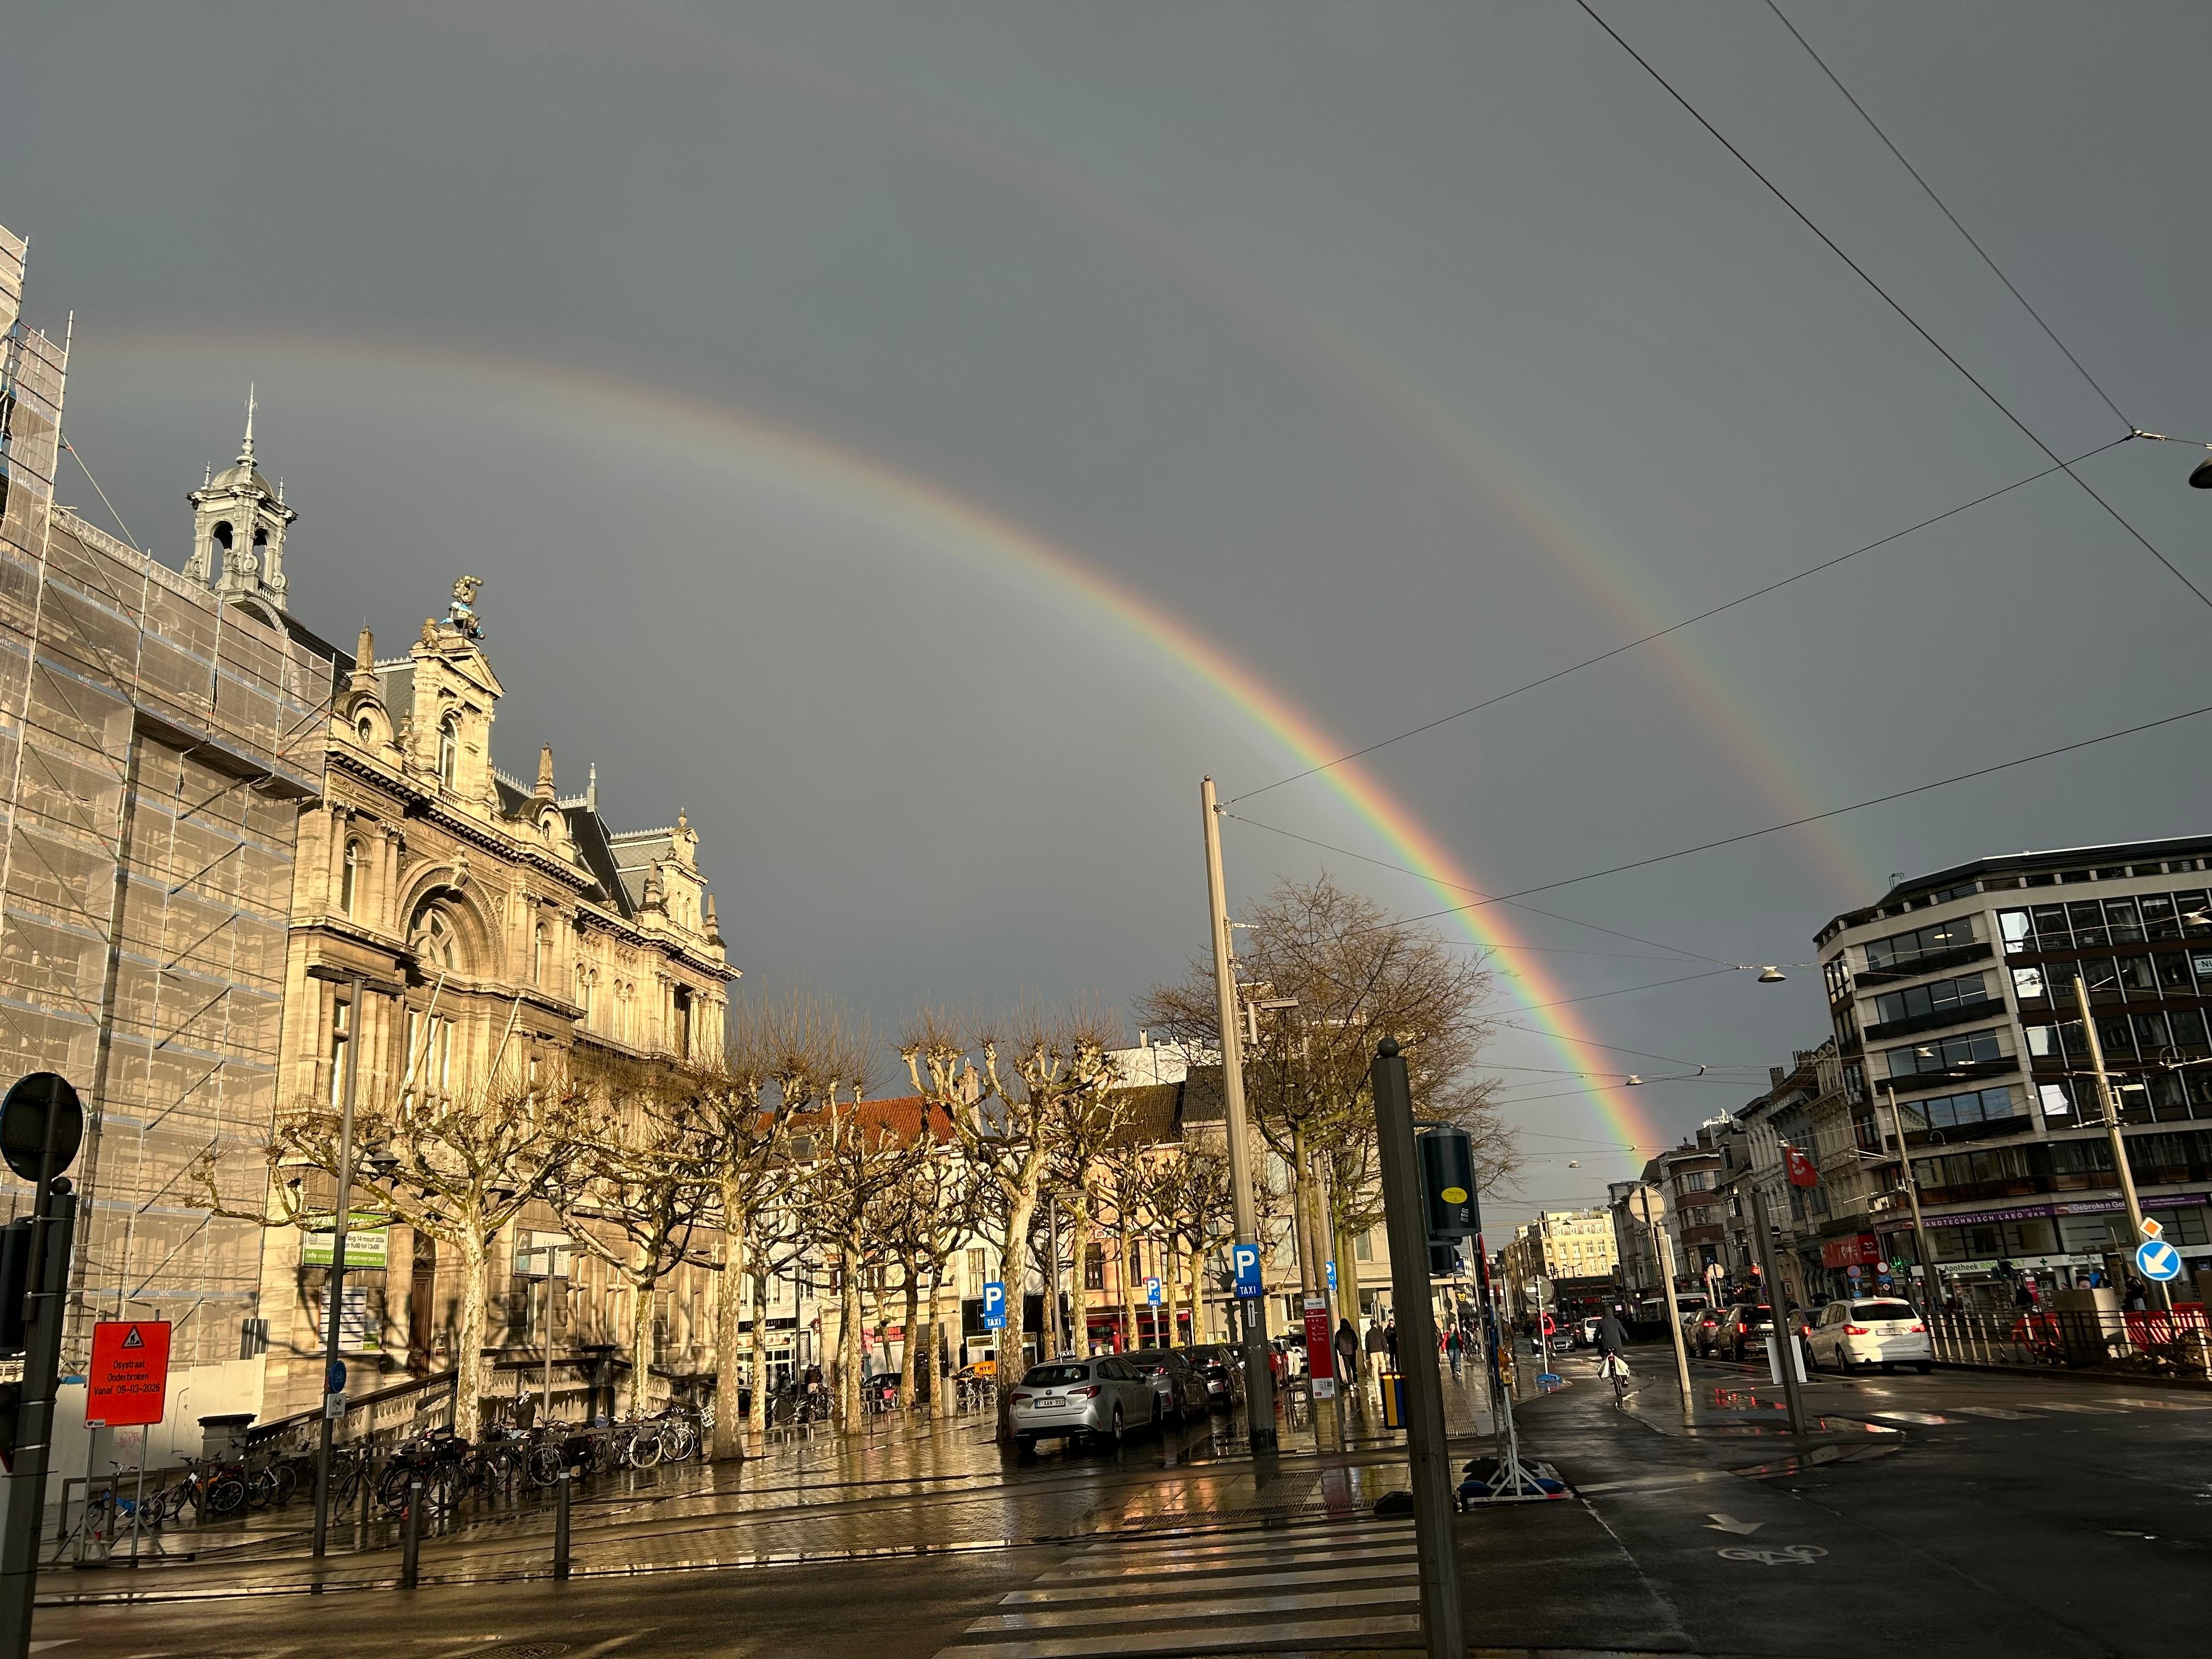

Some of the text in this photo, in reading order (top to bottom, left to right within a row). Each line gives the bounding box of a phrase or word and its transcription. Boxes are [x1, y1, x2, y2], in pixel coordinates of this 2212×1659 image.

[0, 638, 14, 648] MSC
[78, 674, 92, 686] MSC
[243, 680, 255, 690] MSC
[167, 714, 179, 725] MSC
[237, 748, 247, 758] MSC
[205, 822, 216, 832] MSC
[263, 846, 273, 855] MSC
[198, 895, 209, 905] MSC
[50, 919, 65, 928] MSC
[190, 970, 202, 978] MSC
[40, 1006, 54, 1015] MSC
[18, 1187, 34, 1195] MSC
[2073, 1201, 2111, 1211] Gebroken
[309, 1216, 333, 1226] OPEN
[1922, 1216, 1994, 1228] ANDTECHNISCH
[1999, 1212, 2023, 1221] LABO
[1236, 1250, 1255, 1278] P
[1944, 1259, 2026, 1273] Apotheek ROOELT
[1147, 1280, 1158, 1296] P
[1240, 1285, 1256, 1295] TAXI
[985, 1286, 1002, 1312] P
[986, 1317, 1002, 1327] TAXI
[113, 1360, 145, 1372] Osystraat
[107, 1373, 149, 1383] Onderbroken
[93, 1383, 161, 1396] Vanaf 09-03-2026
